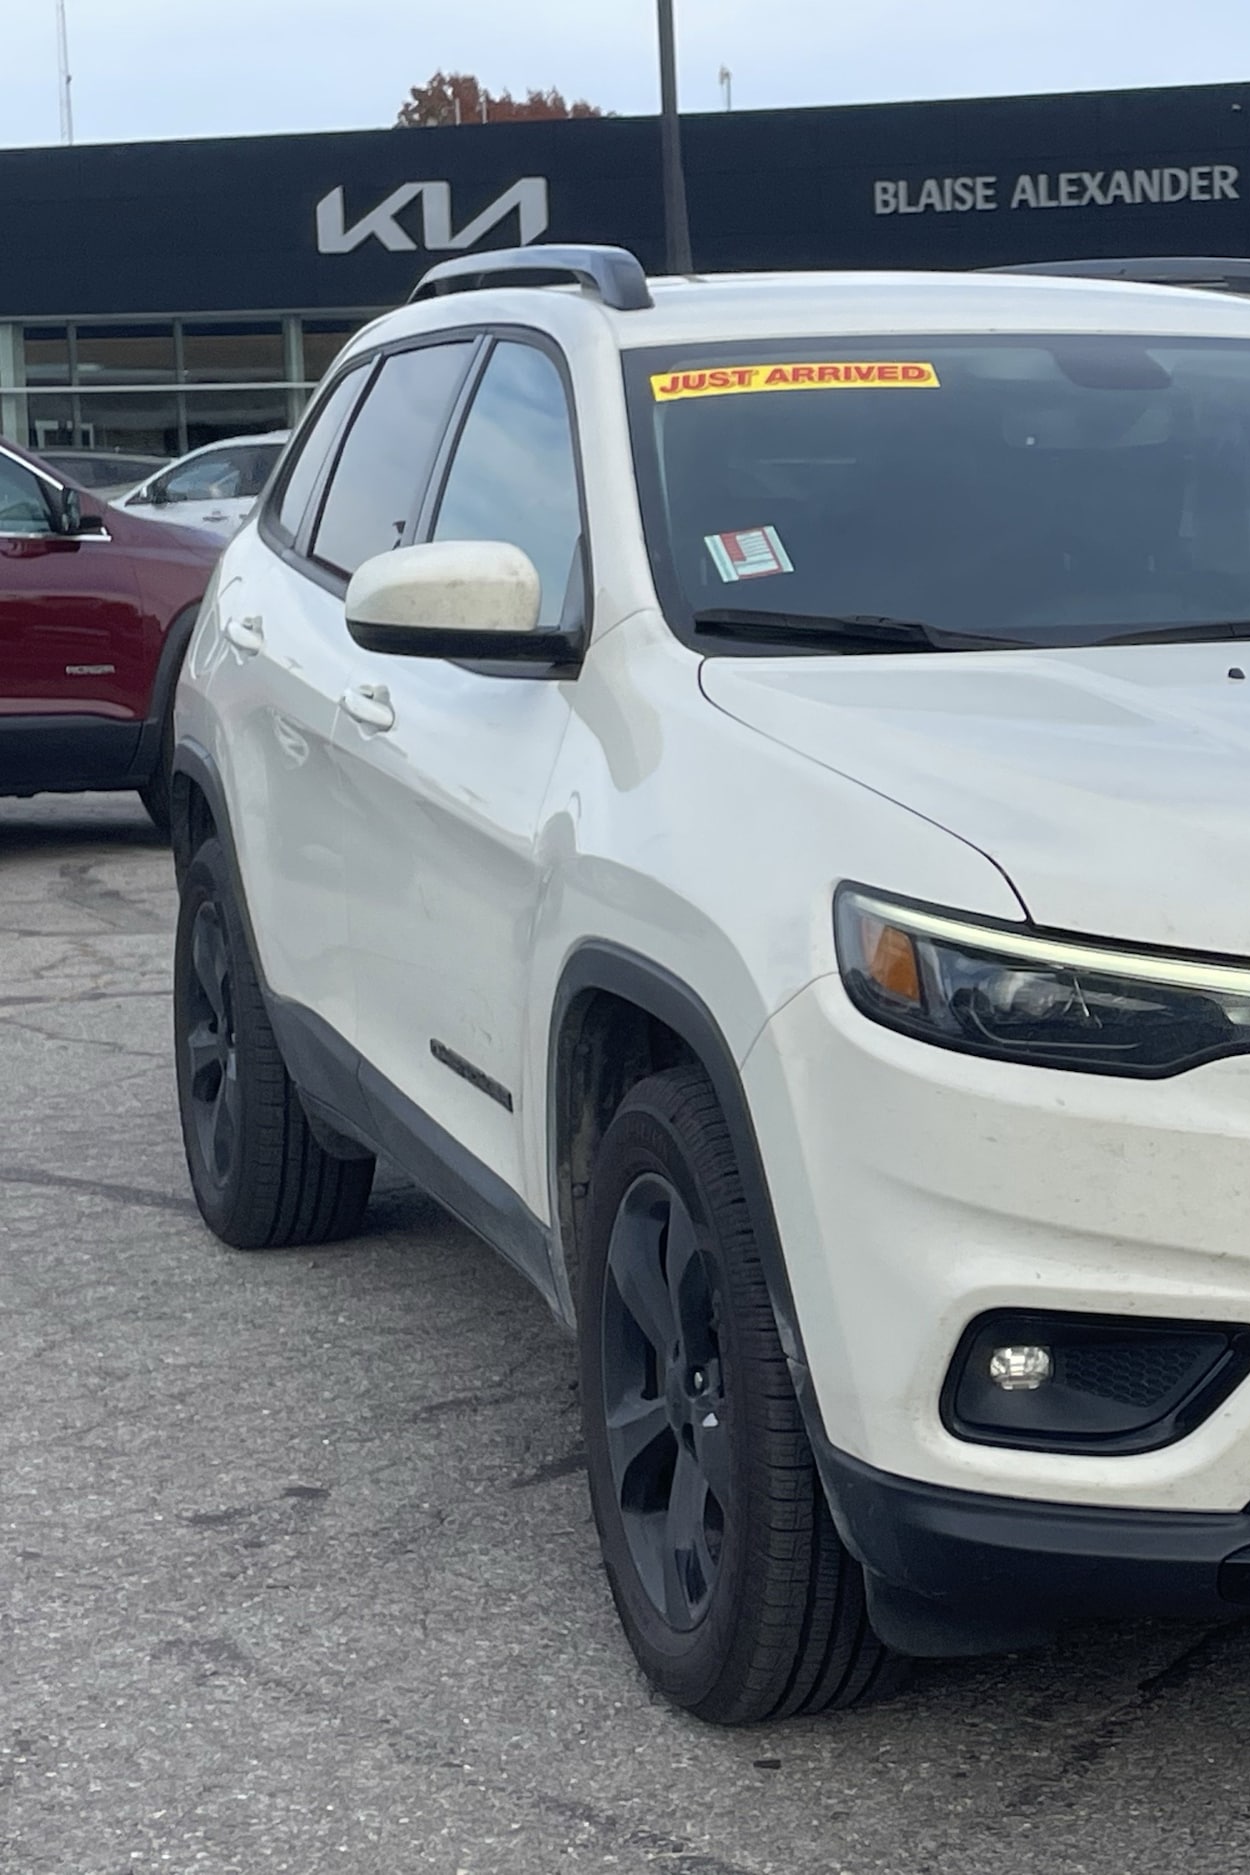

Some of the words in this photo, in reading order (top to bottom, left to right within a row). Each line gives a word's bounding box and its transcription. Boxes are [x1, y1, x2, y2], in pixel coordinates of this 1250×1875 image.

[316, 176, 549, 254] KIA
[874, 176, 998, 215] BLAISE
[1010, 165, 1240, 209] ALEXANDER
[659, 369, 757, 394] JUST
[764, 366, 932, 385] ARRIVED
